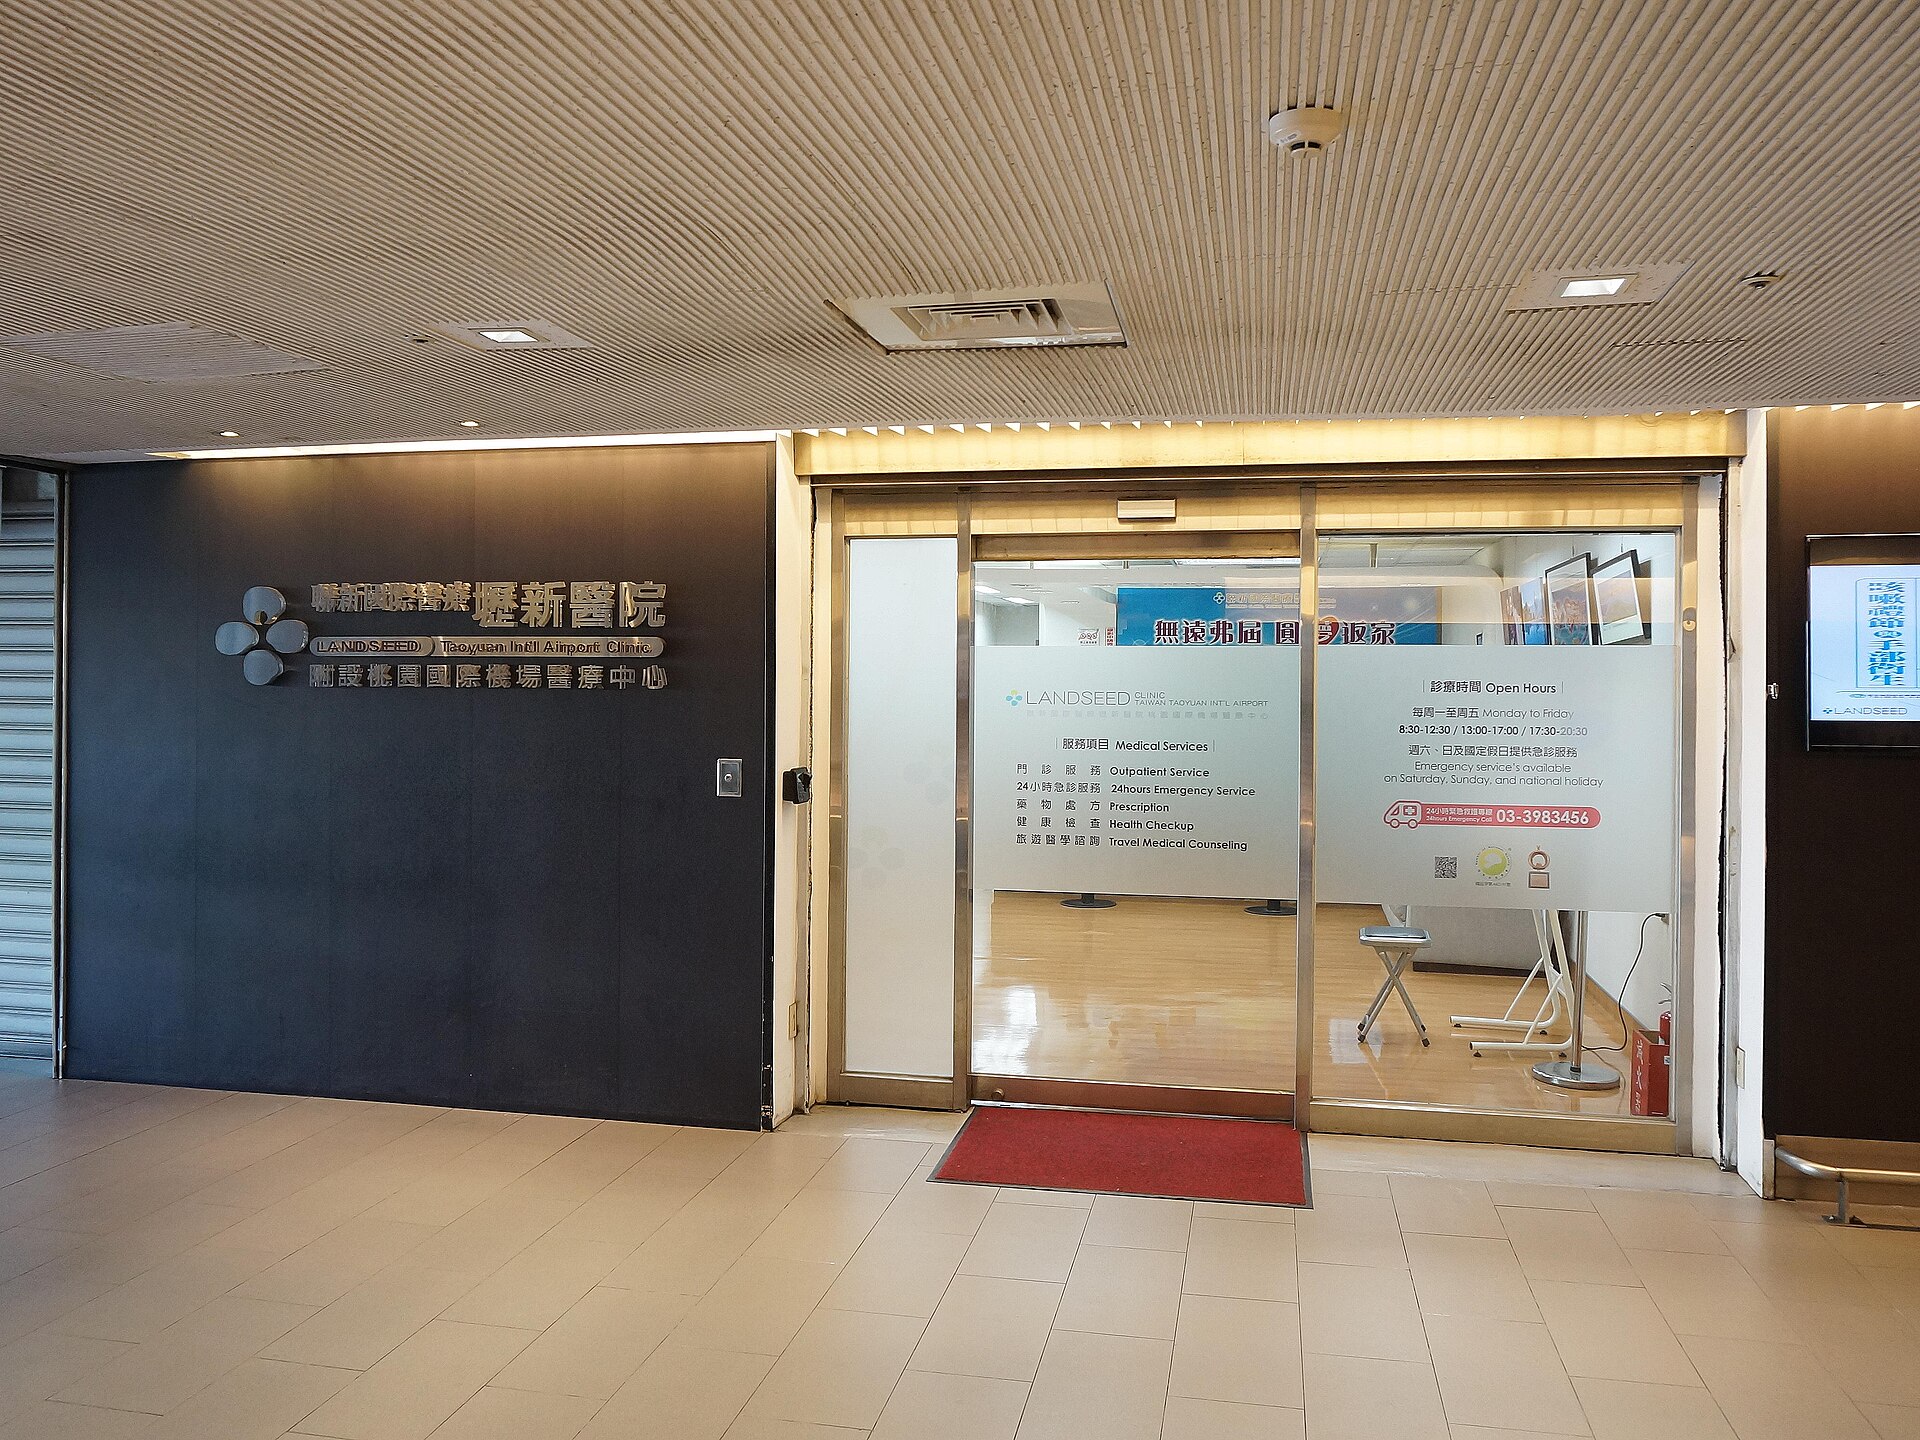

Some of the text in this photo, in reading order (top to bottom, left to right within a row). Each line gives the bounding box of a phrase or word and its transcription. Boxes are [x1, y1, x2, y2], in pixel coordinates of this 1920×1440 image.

[472, 581, 667, 629] 壢新醫院
[1154, 619, 1262, 645] 無遠弗屆
[316, 640, 422, 653] LANDSEED
[440, 640, 504, 656] Taoyuan
[544, 640, 601, 656] Airport
[606, 640, 652, 654] Clinic
[309, 663, 668, 690] 附設桃園國際機場醫療中心
[1134, 691, 1166, 699] CLINIC
[1430, 681, 1557, 695] 診療時間 Open Hours
[1026, 691, 1131, 706] LANDSEED
[1412, 707, 1574, 720] 每周一至周五 Monday to Friday
[1834, 707, 1908, 715] LANDSEED
[1399, 725, 1451, 735] 8:30-12:30
[1461, 726, 1519, 736] 13:00-17:00
[1530, 727, 1588, 736] 17:30-20:30
[1062, 738, 1208, 752] 服務項目 Medical Services
[1016, 764, 1210, 778] 門診服務 Outpatient Service
[1414, 762, 1572, 773] Emergency service's available
[1016, 781, 1256, 797] 24小時急診服務 24hours Emergency Service
[1400, 775, 1449, 785] Saturday,
[1451, 775, 1493, 786] Sunday,
[1495, 776, 1517, 785] and
[1519, 776, 1563, 786] national
[1564, 777, 1604, 788] holiday
[1016, 799, 1170, 814] 藥物處方 Prescription
[1016, 816, 1195, 832] 健康檢查 Health Checkup
[1496, 809, 1590, 825] 03-3983456
[1016, 833, 1248, 852] 旅遊醫學諮詢 Travel Medical Counseling
